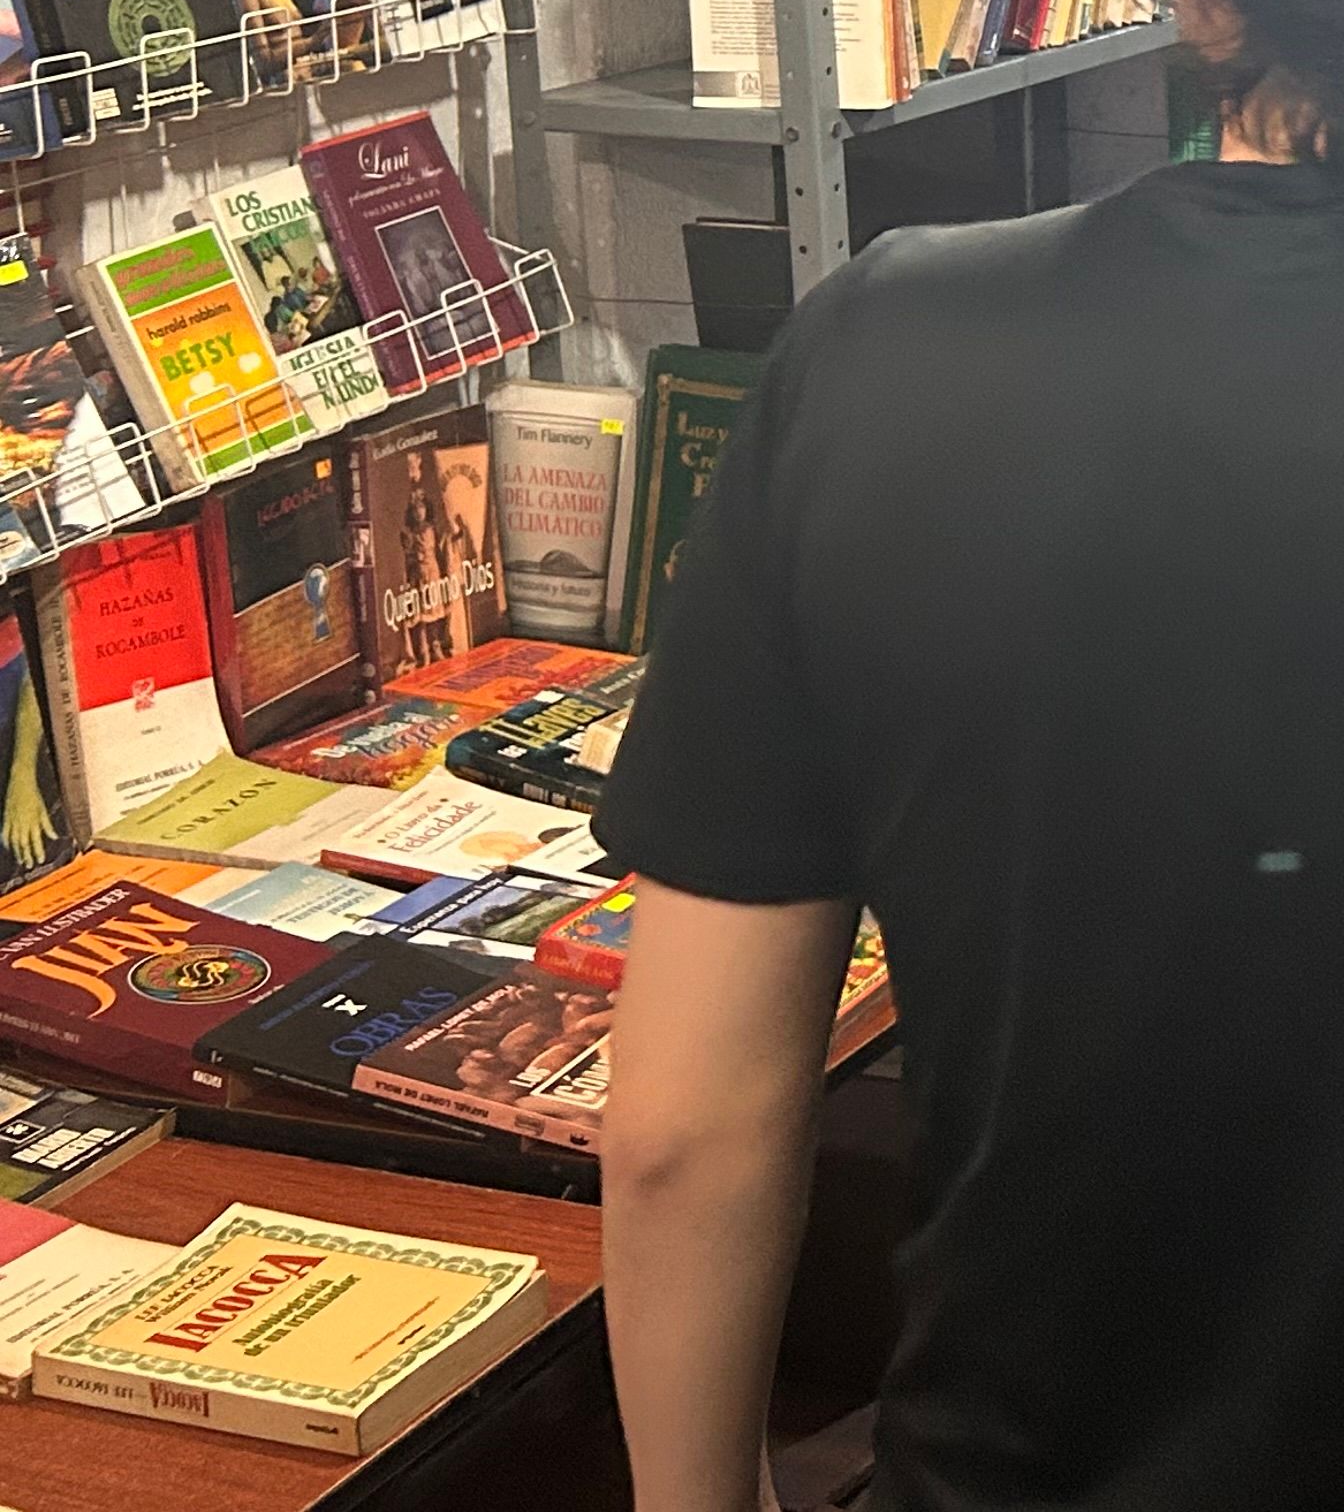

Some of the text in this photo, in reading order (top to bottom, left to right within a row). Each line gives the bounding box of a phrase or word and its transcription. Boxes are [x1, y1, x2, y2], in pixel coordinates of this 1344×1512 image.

[225, 191, 262, 218] LOS
[146, 302, 232, 340] harold robbins
[160, 331, 236, 381] BETSY
[517, 425, 593, 450] Tim Flannery
[504, 464, 608, 490] LA AMENAZA
[504, 487, 606, 514] DEL CAMBIO
[99, 586, 175, 617] HAZAÑAS
[384, 559, 495, 632] Quién como Dios
[95, 623, 187, 660] ROCAMBOLE
[388, 800, 483, 855] Felicidade
[40, 888, 131, 937] LUSTBADER
[11, 901, 201, 1021] JIAN
[329, 986, 459, 1059] OBRAS
[404, 1026, 447, 1053] RAFAEL
[508, 1067, 552, 1089] LOS
[143, 1254, 329, 1353] IACOCCA
[290, 1273, 362, 1329] triunfador
